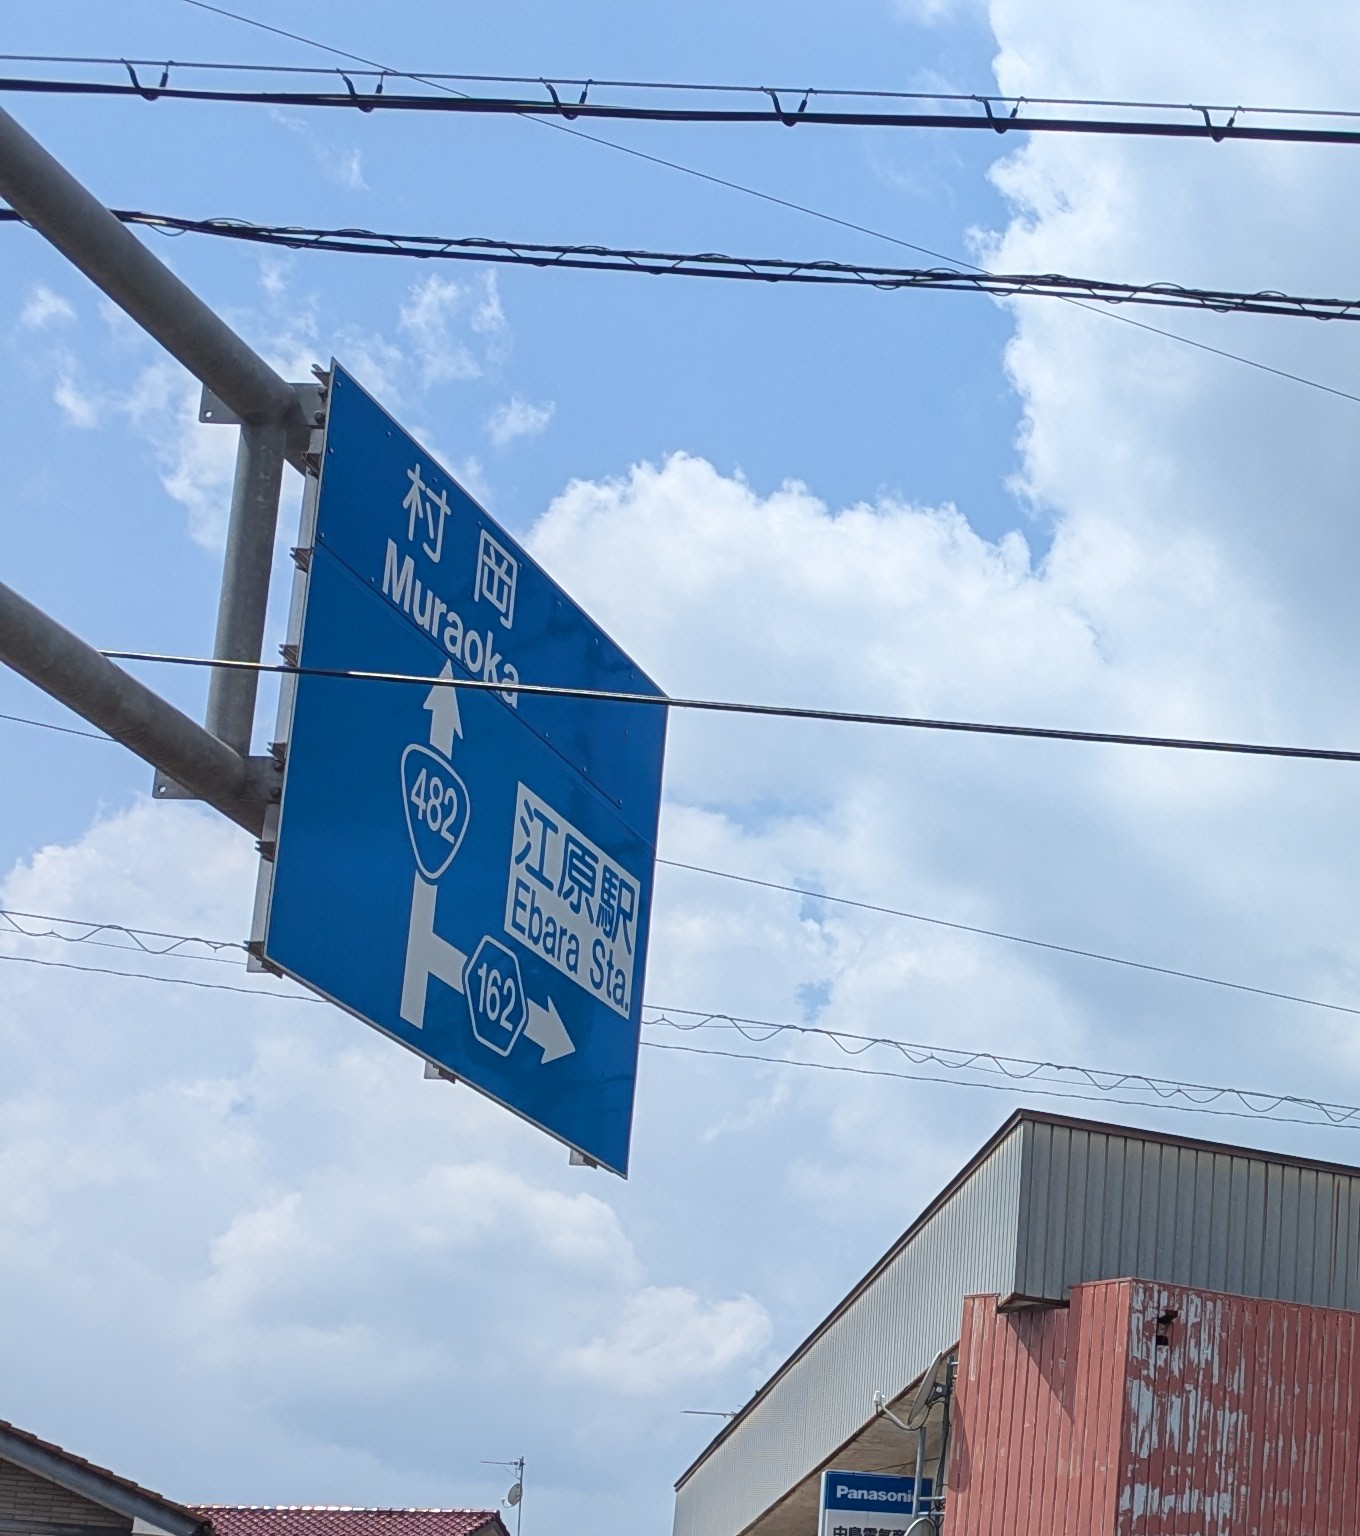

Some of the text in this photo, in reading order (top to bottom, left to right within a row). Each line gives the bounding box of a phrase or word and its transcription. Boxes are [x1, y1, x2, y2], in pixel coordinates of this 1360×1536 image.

[402, 463, 518, 630] 村岡
[382, 537, 519, 710] Muraoka
[410, 767, 458, 845] 482
[511, 876, 630, 1013] Ebara Sta.
[514, 798, 636, 956] 江原駅
[477, 962, 516, 1033] 162
[836, 1484, 915, 1503] Panasoni
